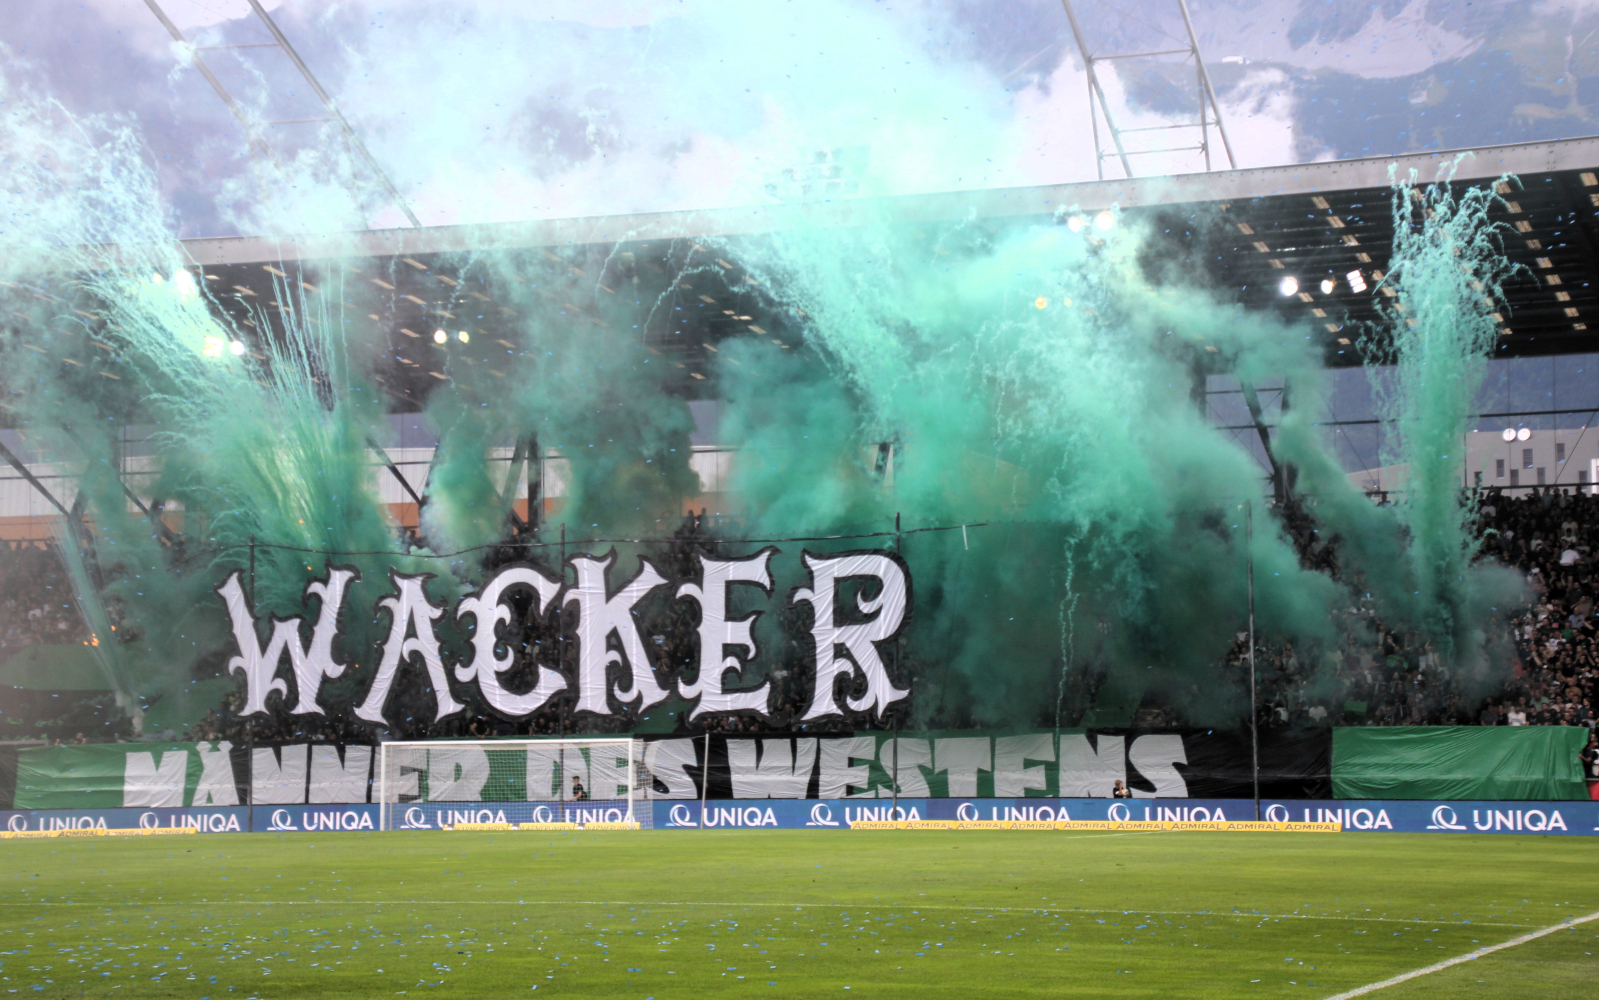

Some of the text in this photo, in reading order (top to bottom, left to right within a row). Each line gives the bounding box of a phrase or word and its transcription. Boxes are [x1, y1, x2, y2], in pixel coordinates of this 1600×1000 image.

[215, 549, 910, 725] WACKER
[123, 734, 1188, 807] MÄNNER DES WESTENS
[302, 811, 374, 831] UNIQA
[437, 810, 508, 828] UNIQA
[703, 807, 778, 827] UNIQA
[845, 806, 921, 826] UNIQA
[992, 806, 1071, 821] UNIQA
[1145, 807, 1226, 821] UNIQA
[1304, 808, 1393, 829] UNIQA
[1473, 810, 1568, 831] UNIQA
[40, 816, 107, 831] UNIQA
[171, 814, 240, 832] UNIQA
[853, 822, 901, 830] ADMIRAL
[905, 822, 953, 830] ADMIRAL
[957, 822, 1005, 830] ADMIRAL
[1010, 822, 1059, 830] ADMIRAL
[1063, 822, 1113, 830] ADMIRAL
[1116, 822, 1167, 830] ADMIRAL
[1227, 823, 1280, 831] ADMIRAL
[1284, 823, 1339, 831] ADMIRAL
